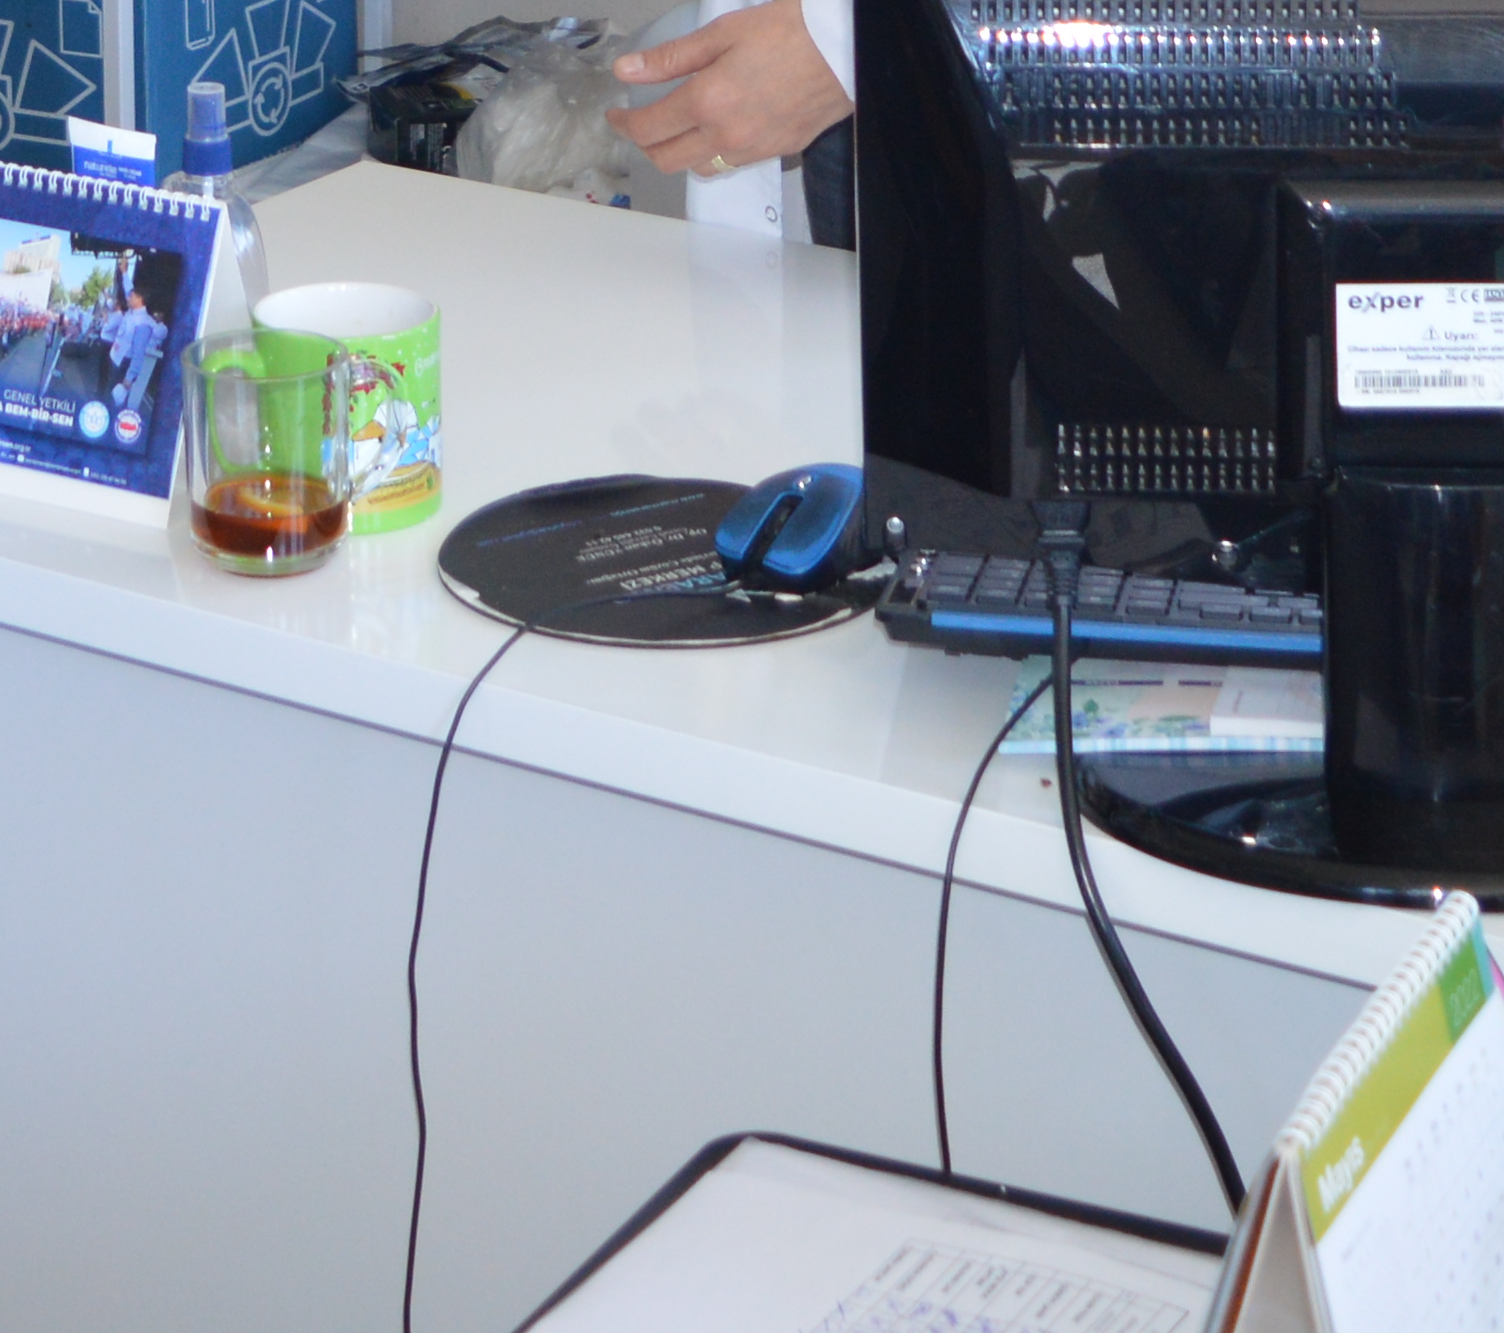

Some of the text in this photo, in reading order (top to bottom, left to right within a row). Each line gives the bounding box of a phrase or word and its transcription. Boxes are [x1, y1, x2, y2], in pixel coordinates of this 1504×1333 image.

[1347, 292, 1424, 313] exper
[4, 389, 76, 414] GENEL YETKİLİ
[4, 404, 74, 427] BEM-BİR-SEN
